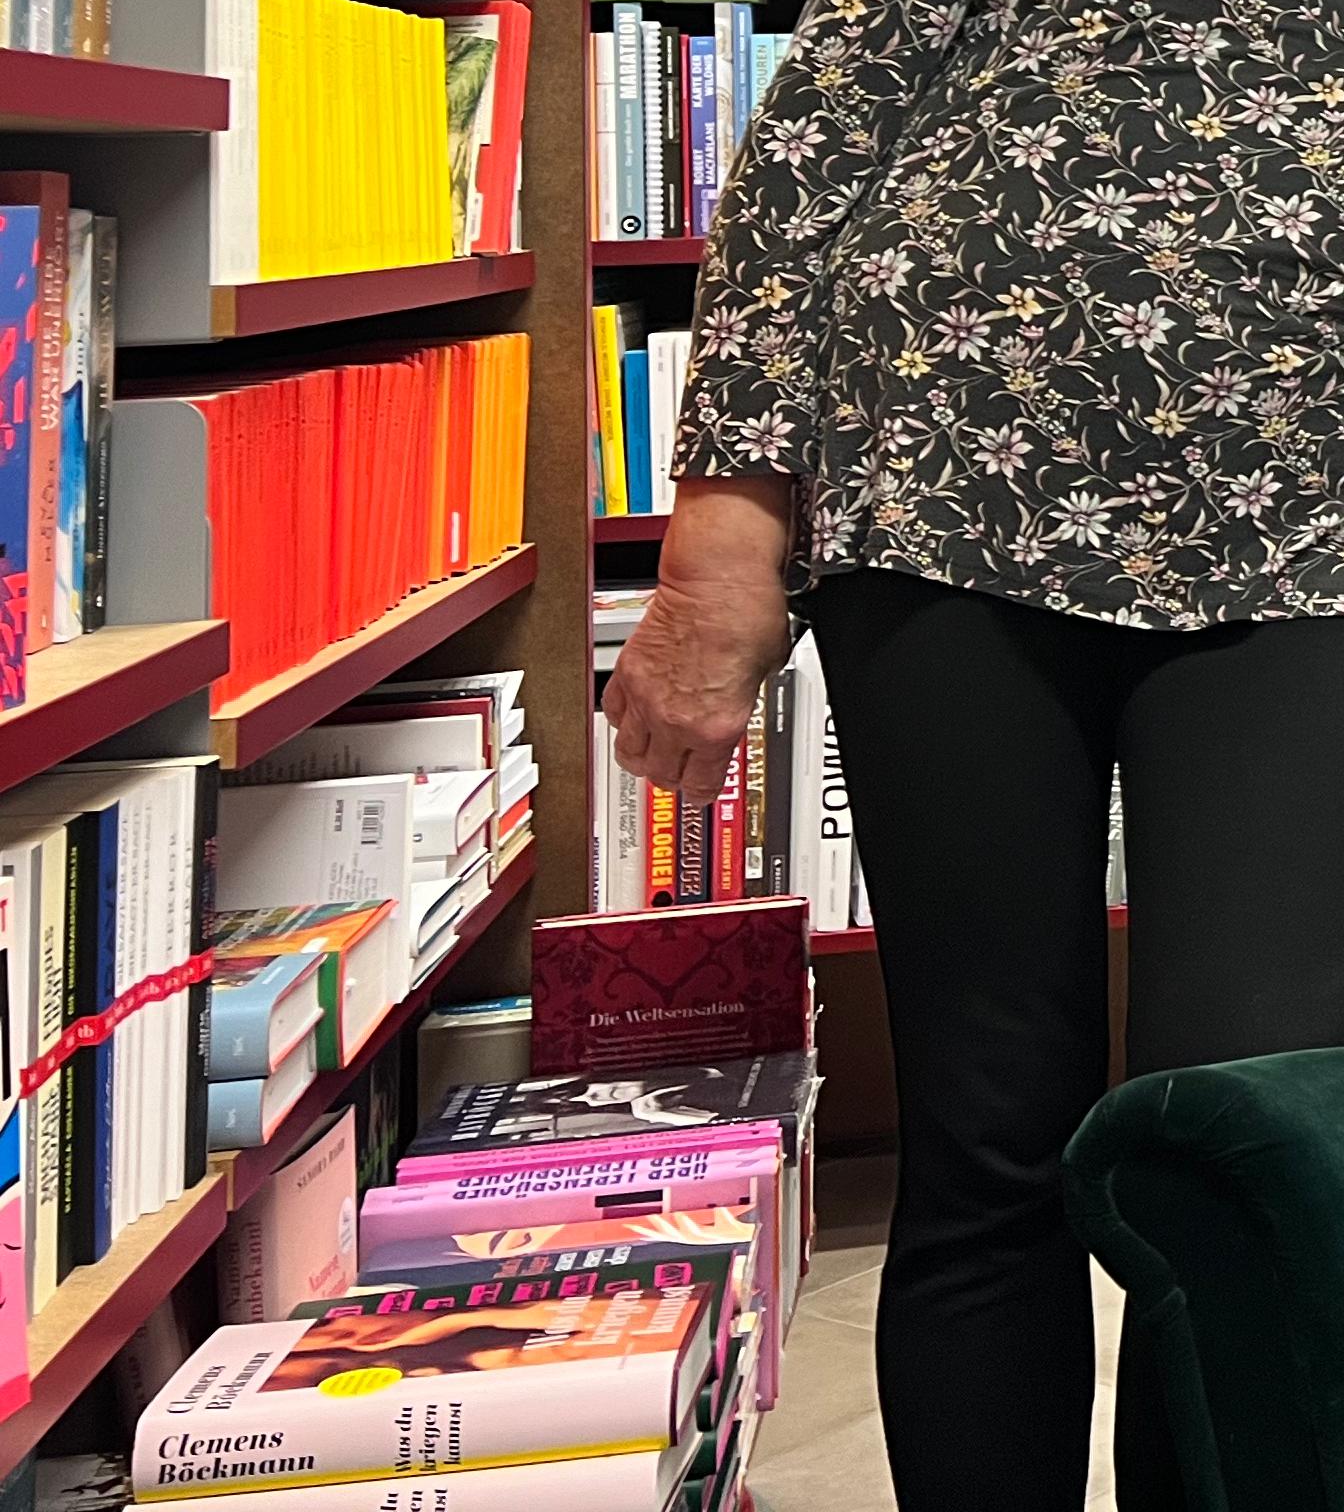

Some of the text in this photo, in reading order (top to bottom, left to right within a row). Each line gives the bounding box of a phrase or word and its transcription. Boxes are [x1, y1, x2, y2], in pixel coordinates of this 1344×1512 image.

[618, 10, 638, 100] MARATHON
[702, 54, 714, 97] WILDNIS
[692, 76, 703, 109] KARTE
[692, 148, 704, 186] ROBERT
[703, 120, 717, 186] MACFARLANE
[717, 746, 740, 821] DIE LEC
[821, 705, 853, 840] POW
[722, 827, 732, 866] ANDERSEN
[588, 998, 747, 1029] Die Weltsensation
[451, 1173, 635, 1200] LEBENSBÜCHER
[166, 1364, 226, 1414] Clemens
[205, 1351, 274, 1411] Böckmann
[158, 1431, 284, 1460] Clemens
[395, 1406, 413, 1473] Was du
[419, 1404, 442, 1472] kriegen
[444, 1402, 462, 1465] kannst
[157, 1455, 315, 1485] Böckmann
